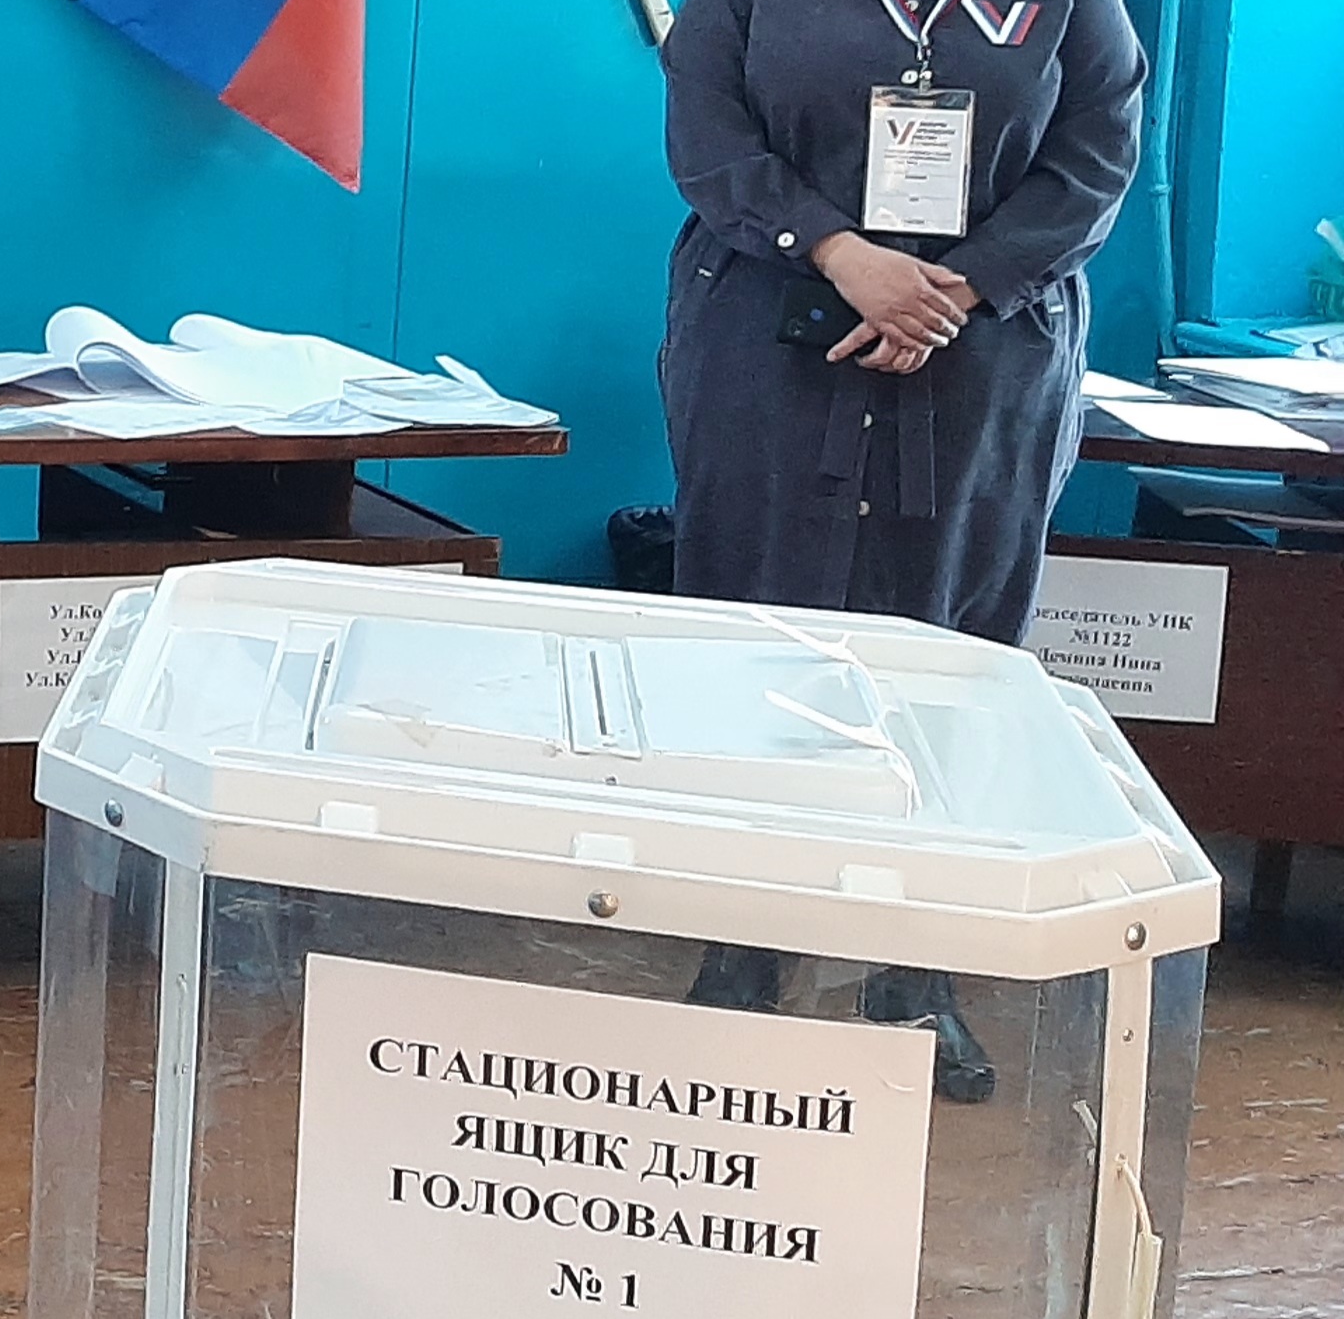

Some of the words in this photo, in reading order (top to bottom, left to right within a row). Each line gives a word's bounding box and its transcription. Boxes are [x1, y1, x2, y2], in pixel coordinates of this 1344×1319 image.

[50, 604, 103, 619] Ул.Ко
[1148, 612, 1194, 631] УИК
[368, 1036, 855, 1135] СТАЦИОНАРНЫЙ
[452, 1113, 629, 1172] ЯЩИК
[640, 1142, 759, 1192] ДЛЯ
[389, 1165, 821, 1264] ГОЛОСОВАНИЯ
[619, 1273, 640, 1309] 1
